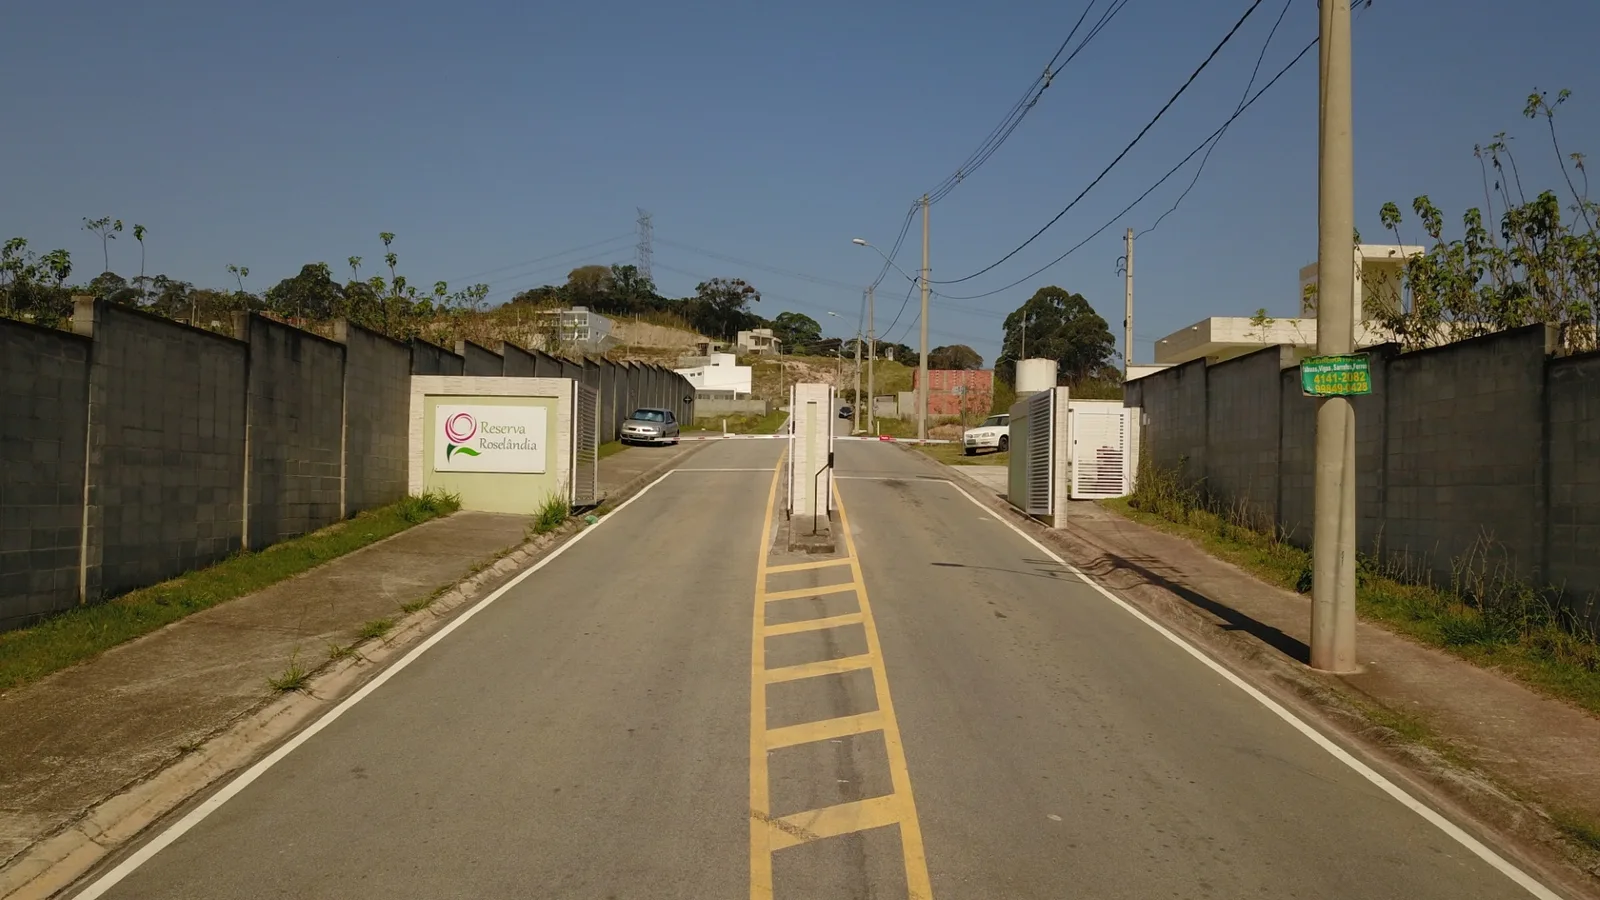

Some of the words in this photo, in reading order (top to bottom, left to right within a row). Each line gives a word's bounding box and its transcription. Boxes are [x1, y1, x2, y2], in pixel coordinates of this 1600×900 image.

[1314, 371, 1365, 383] 4141-2082
[480, 421, 526, 435] Reserva
[479, 437, 537, 450] Roselândia
